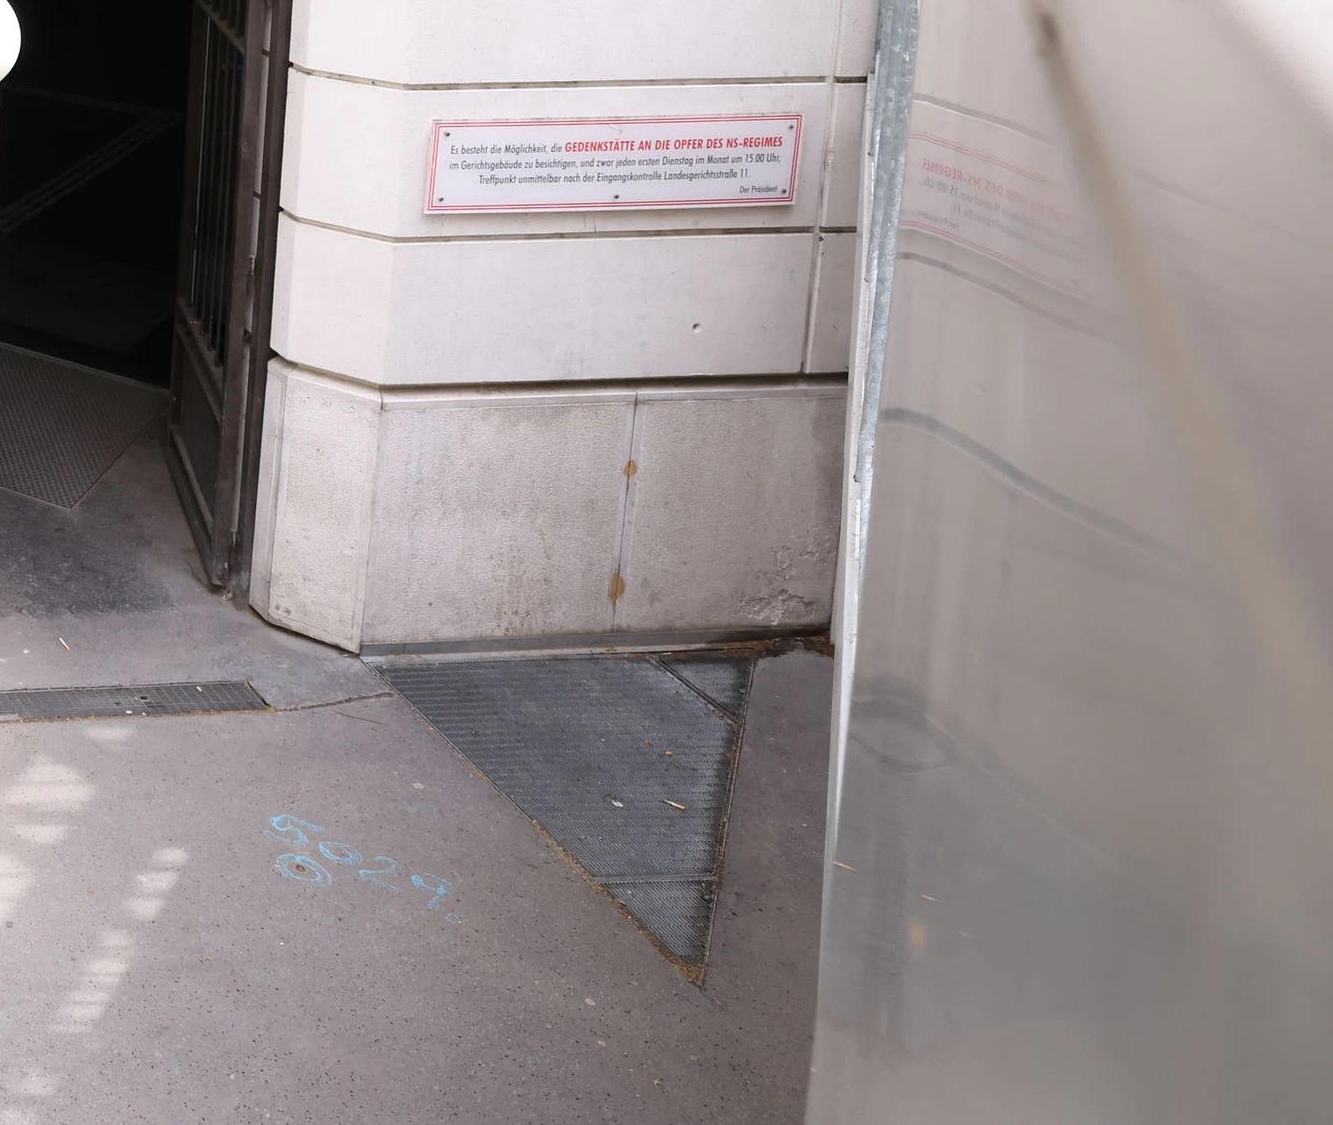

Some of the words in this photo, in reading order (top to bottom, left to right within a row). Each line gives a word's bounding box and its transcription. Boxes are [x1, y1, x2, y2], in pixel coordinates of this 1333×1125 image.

[451, 145, 458, 154] Es
[462, 144, 488, 154] besteht
[490, 144, 501, 153] die
[504, 142, 548, 155] Möglichkeit,
[551, 142, 562, 153] die
[565, 138, 635, 153] GEDENKSTÄTTE
[638, 140, 651, 150] AN
[655, 140, 670, 150] DIE
[674, 139, 703, 150] OPFER
[706, 138, 723, 149] DES
[726, 136, 783, 148] NS-REGIMES
[449, 161, 458, 170] im
[461, 160, 522, 171] Gerichtsgebäude
[525, 161, 533, 169] zu
[535, 159, 578, 170] besichtigen,
[581, 158, 595, 167] und
[616, 159, 636, 168] jeden
[638, 157, 660, 166] ersten
[662, 156, 693, 167] Dienstag
[695, 156, 704, 164] im
[707, 155, 729, 164] Monat
[745, 153, 764, 163] 15.00
[766, 153, 781, 164] Uhr,
[479, 175, 516, 186] Treffpunkt
[519, 174, 561, 183] unmittelbar
[564, 173, 580, 182] nach
[583, 173, 594, 182] der
[597, 171, 662, 184] Eingangskontrolle
[664, 169, 737, 181] Landesgerichtsstraße
[740, 169, 750, 178] 11.
[740, 186, 749, 194] Der
[752, 185, 777, 193] Präsident
